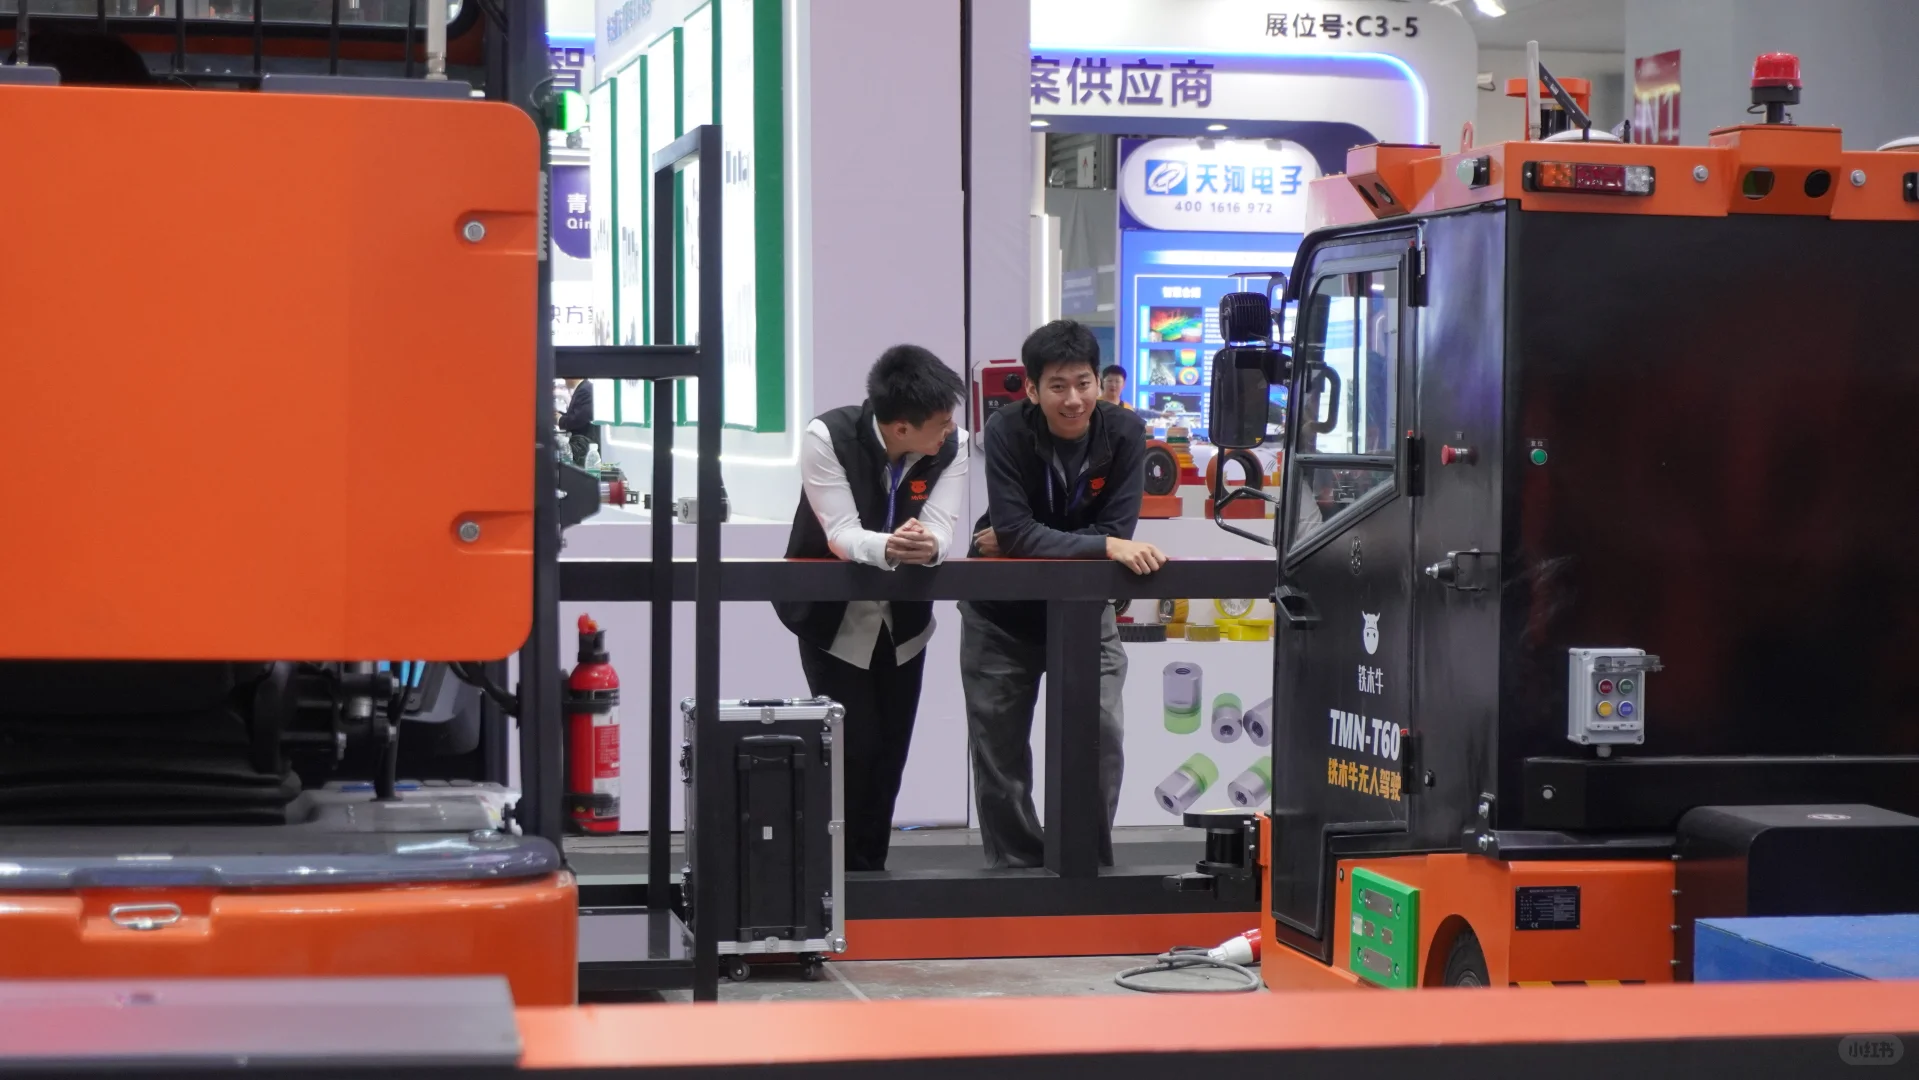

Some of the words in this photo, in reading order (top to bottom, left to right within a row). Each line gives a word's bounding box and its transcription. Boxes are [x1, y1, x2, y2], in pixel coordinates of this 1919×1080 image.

[1265, 12, 1419, 39] 展位号:C3-5
[1031, 54, 1214, 108] 案供应商
[1195, 164, 1303, 195] 天河电子
[1174, 201, 1202, 213] 400
[1211, 203, 1241, 213] 1616
[1247, 203, 1273, 214] 972
[1358, 664, 1384, 695] 铁木牛
[1330, 708, 1400, 761] TMN-T60
[1328, 757, 1401, 801] 铁木牛无人驾驶
